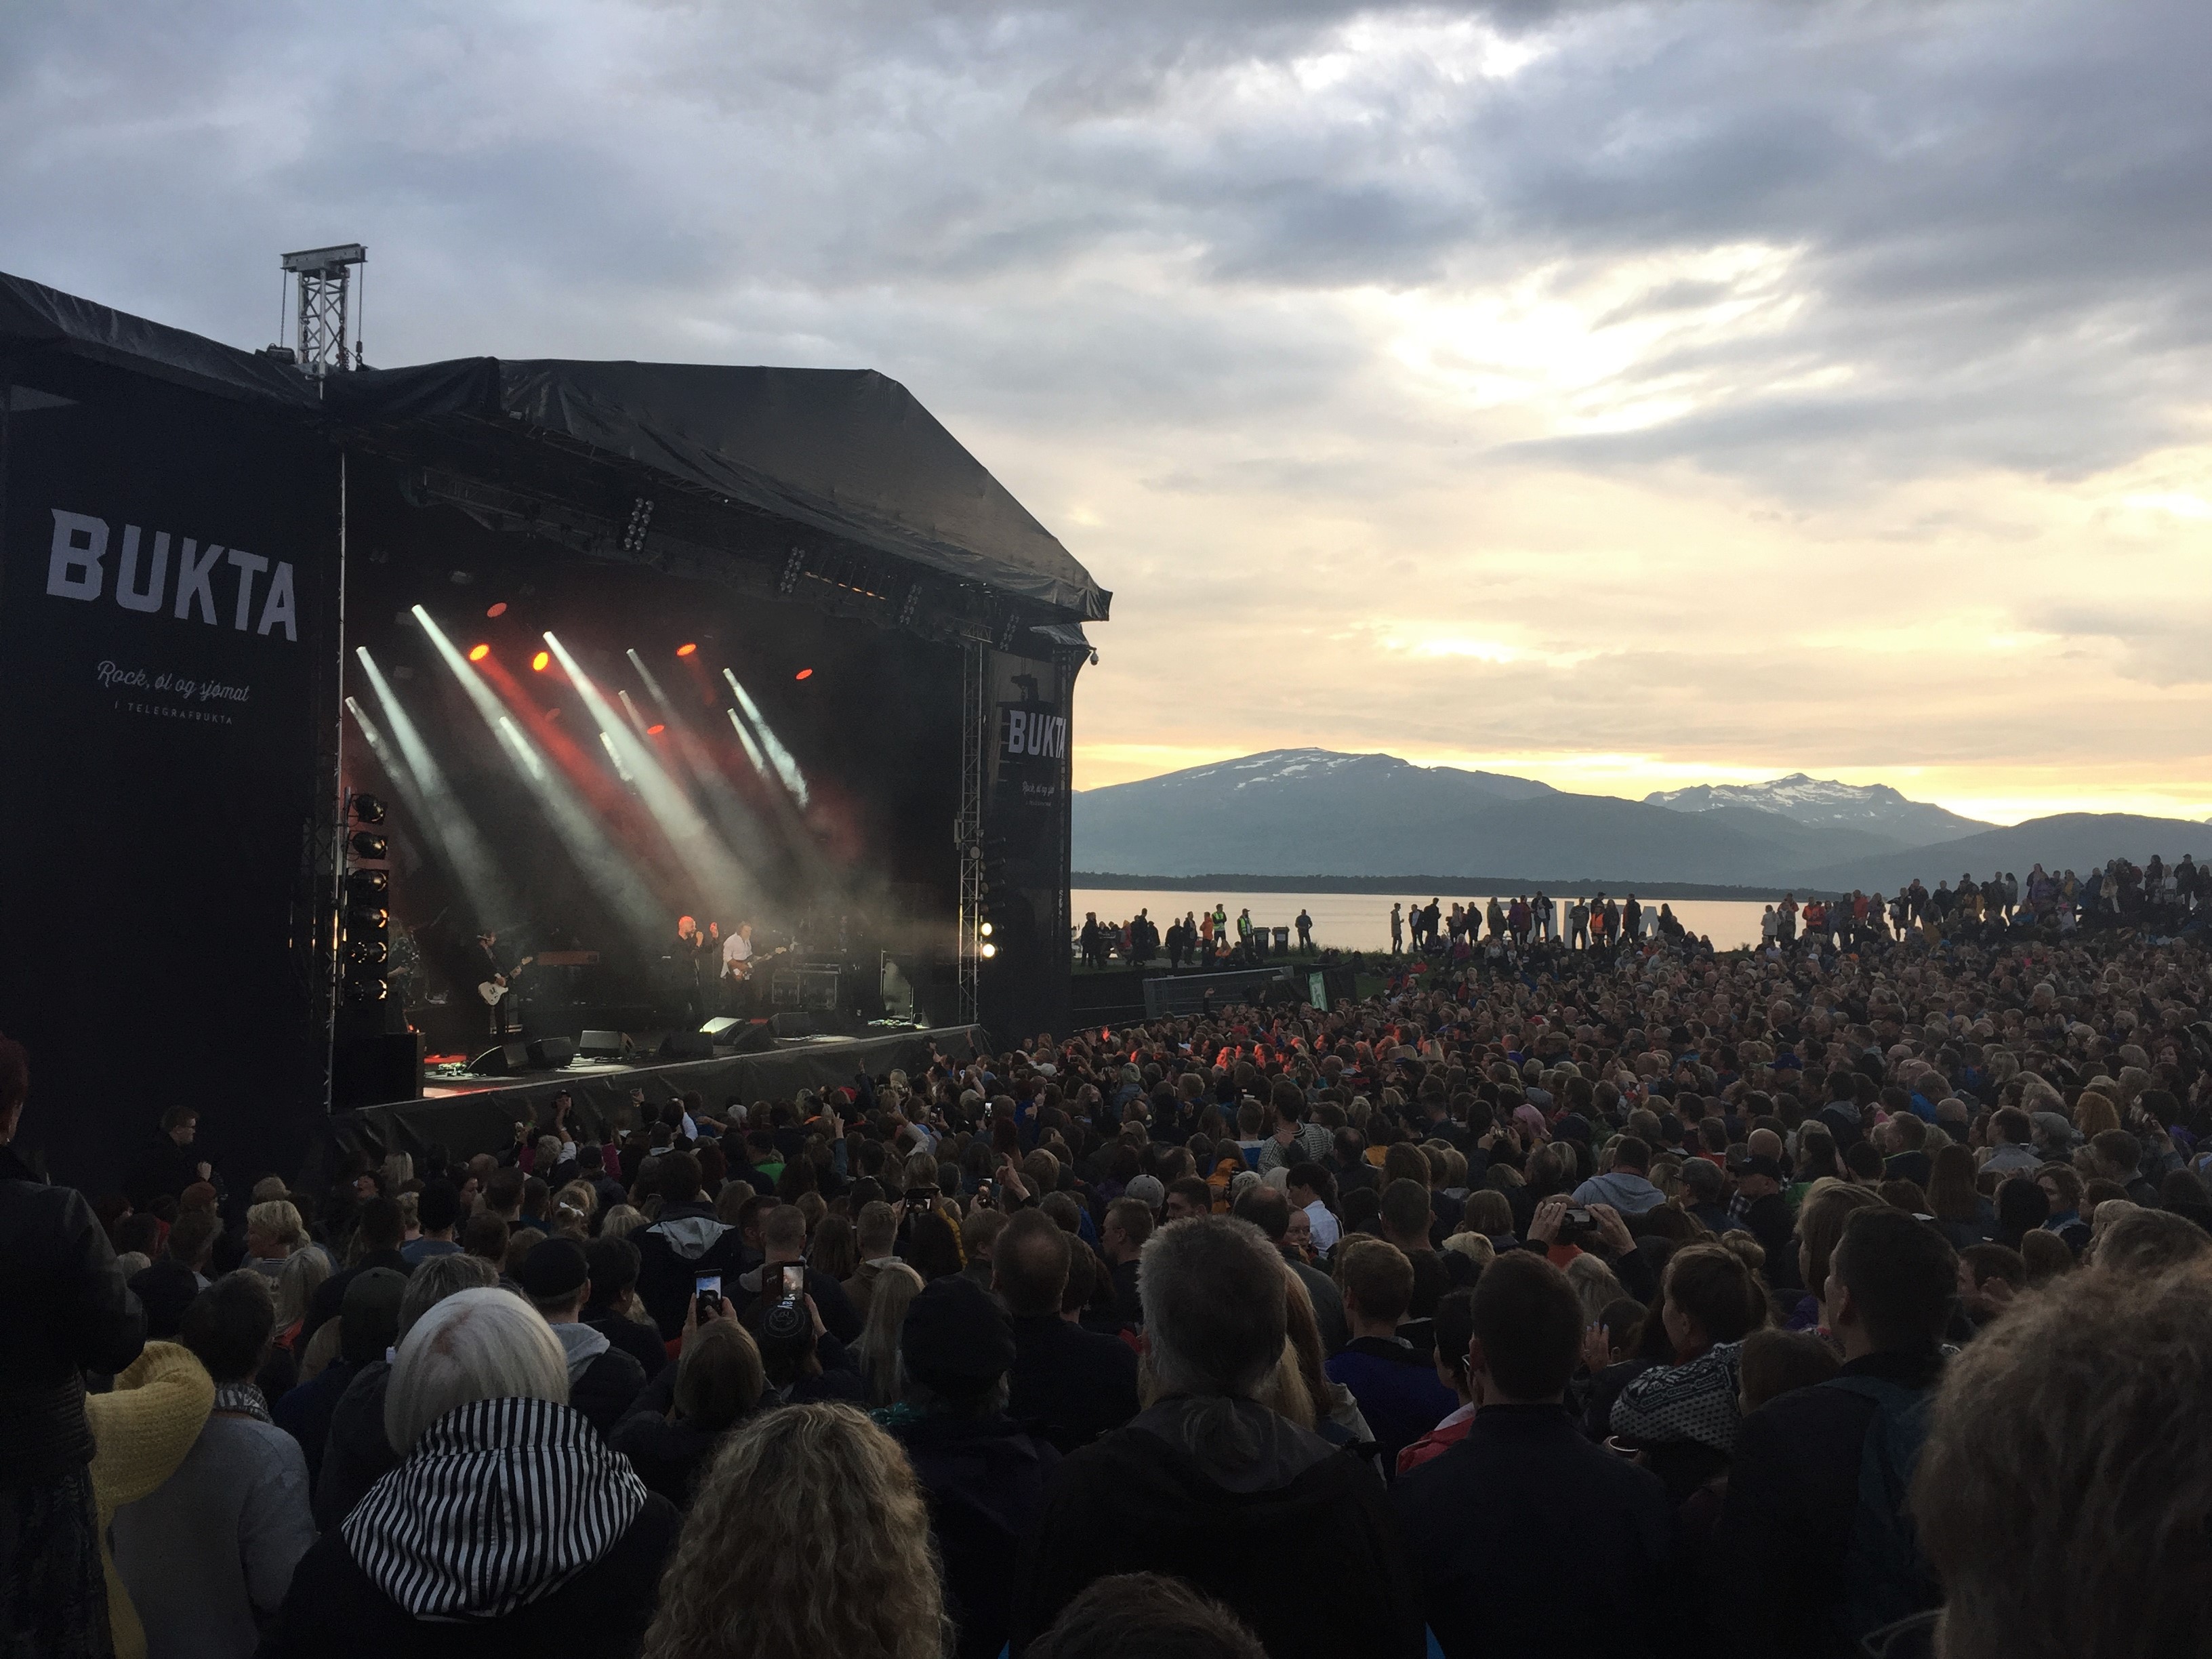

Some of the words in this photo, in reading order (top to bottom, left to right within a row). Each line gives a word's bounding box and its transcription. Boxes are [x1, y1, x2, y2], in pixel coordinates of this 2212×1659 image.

[46, 508, 298, 642] BUKTA
[97, 659, 150, 690] Rock,
[155, 672, 173, 690] øl
[175, 678, 196, 699] og
[199, 680, 250, 703] sjømat
[127, 702, 232, 725] TELEGRAFBUKTA
[1008, 709, 1067, 759] BUKTA
